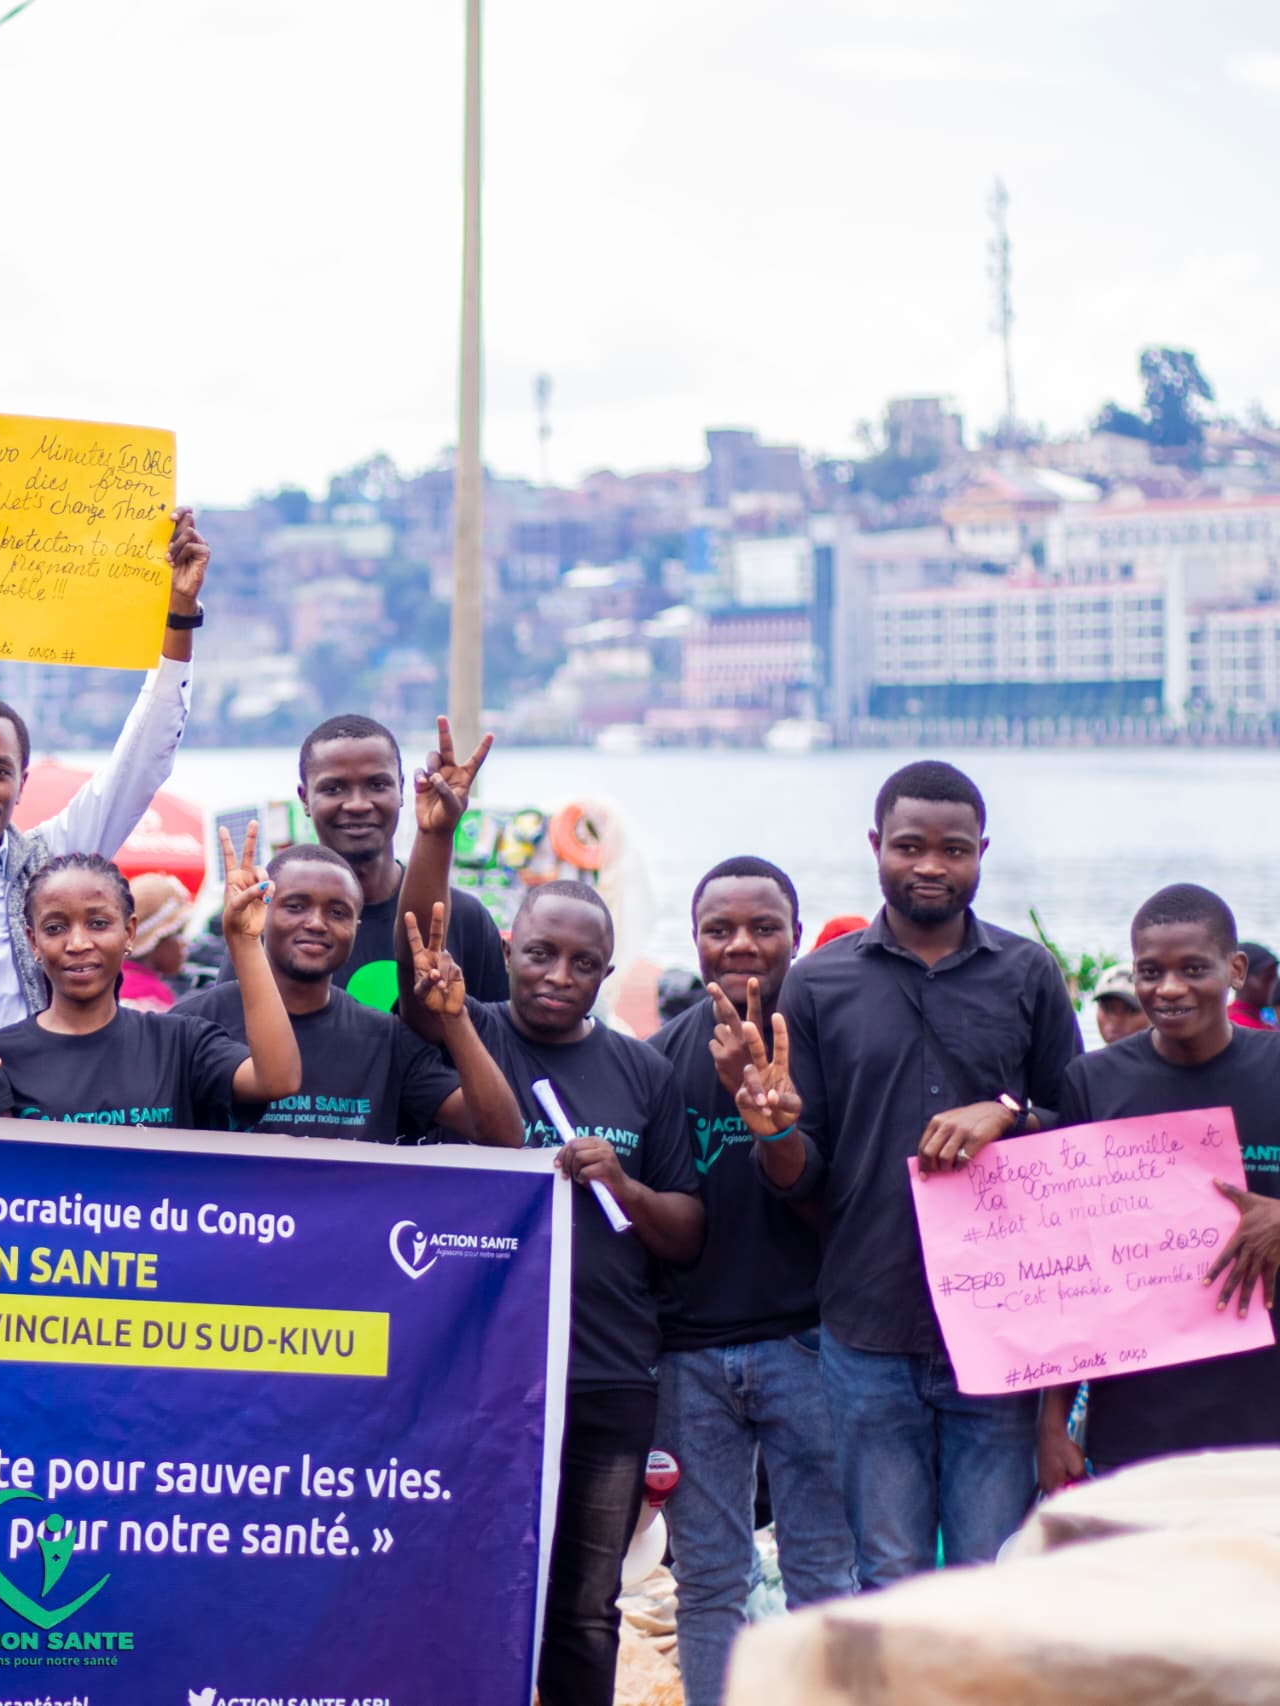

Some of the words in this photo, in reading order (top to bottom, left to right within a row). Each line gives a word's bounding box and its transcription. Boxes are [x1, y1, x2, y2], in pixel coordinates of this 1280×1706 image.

[118, 443, 138, 472] In
[24, 466, 68, 491] dies
[89, 466, 160, 502] from
[91, 529, 108, 556] to
[315, 1096, 371, 1114] SANTE
[294, 1113, 316, 1125] pour
[594, 1125, 639, 1149] SANTE
[1060, 1138, 1093, 1170] ta
[1200, 1123, 1224, 1148] et
[975, 1187, 1008, 1211] ta
[150, 1198, 188, 1232] du
[197, 1204, 296, 1243] Congo
[1040, 1202, 1062, 1228] la
[430, 1233, 478, 1248] ACTION
[480, 1236, 519, 1251] SANTE
[30, 1247, 158, 1289] SANTE
[938, 1271, 1006, 1297] #ZERO
[142, 1320, 187, 1351] DU
[1005, 1362, 1062, 1387] #Action
[48, 1457, 145, 1499] pour
[155, 1458, 291, 1497] sauver
[301, 1454, 355, 1497] les
[365, 1457, 451, 1500] vies.
[119, 1514, 231, 1554] notre
[241, 1512, 360, 1556] santé.
